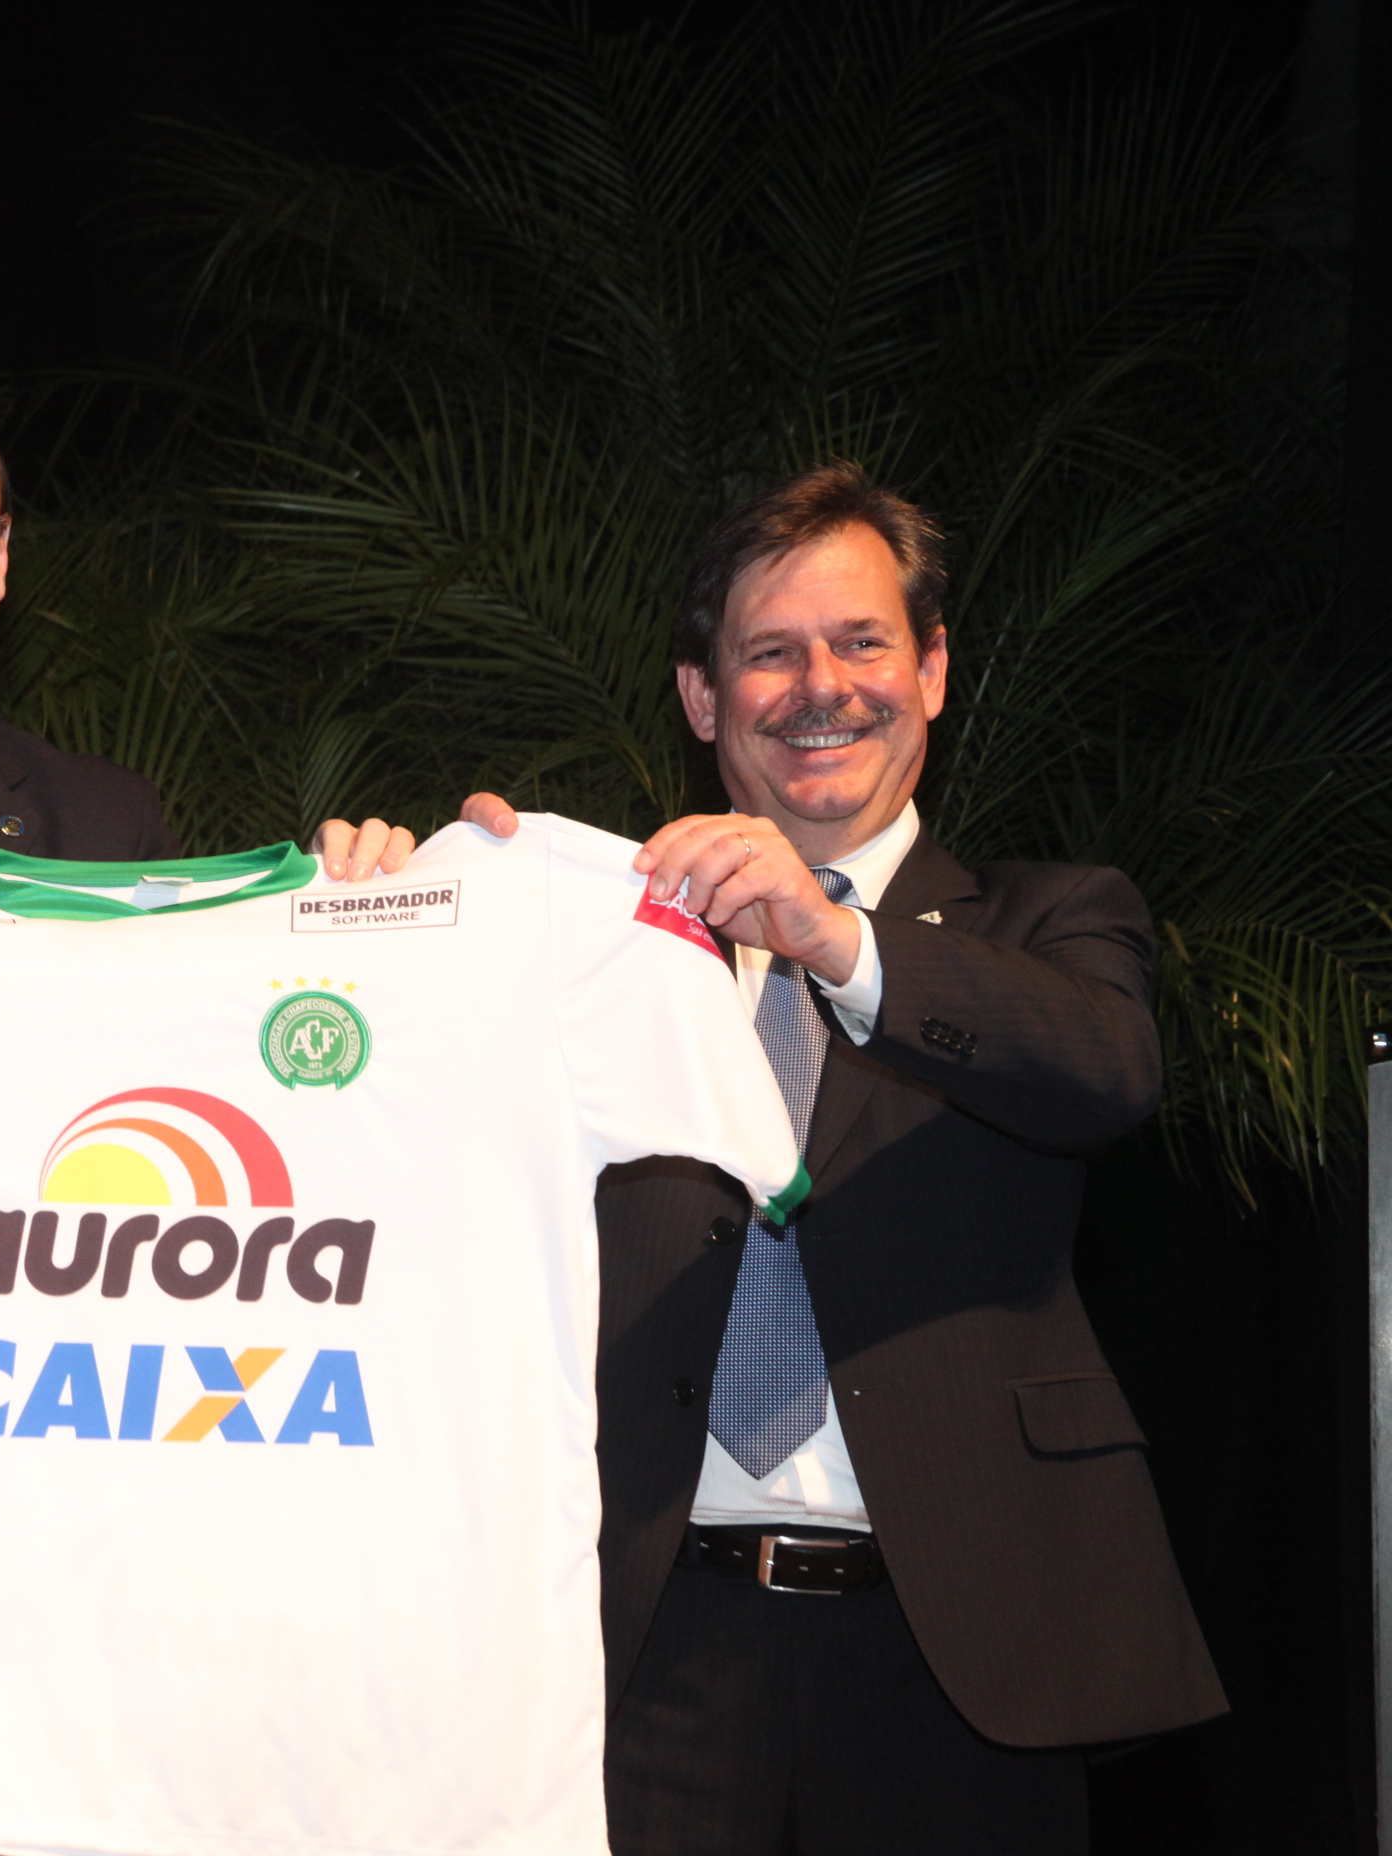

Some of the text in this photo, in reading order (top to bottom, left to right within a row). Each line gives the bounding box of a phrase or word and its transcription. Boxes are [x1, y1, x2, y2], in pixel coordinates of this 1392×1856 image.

[299, 889, 453, 914] DESBRAVADOR
[331, 911, 420, 925] SOFTWARE
[687, 922, 703, 937] Sua
[284, 1000, 347, 1020] CHAPECOENSE
